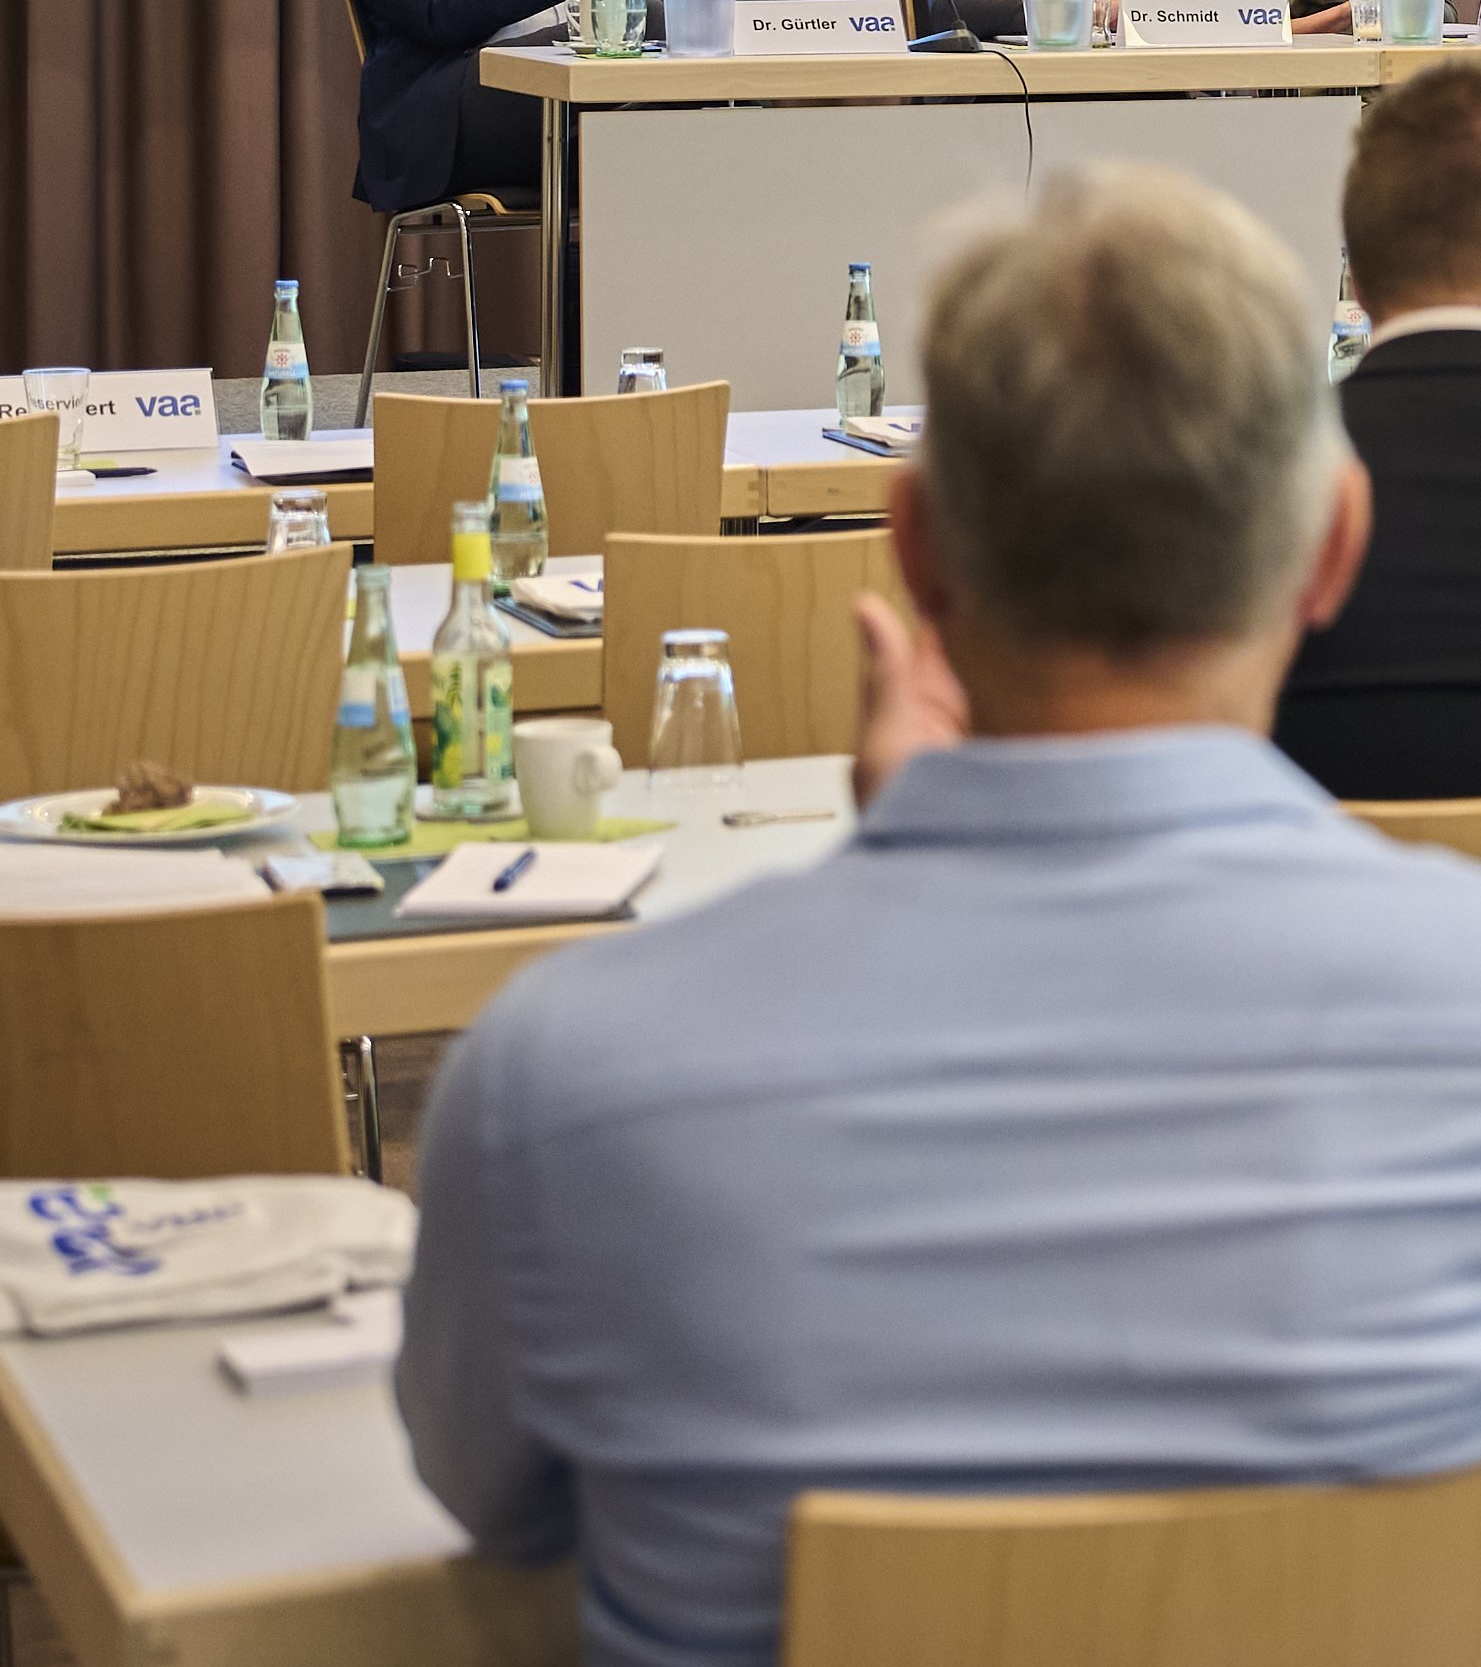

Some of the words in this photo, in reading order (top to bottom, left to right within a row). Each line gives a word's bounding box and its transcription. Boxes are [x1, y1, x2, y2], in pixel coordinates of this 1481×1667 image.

[849, 16, 895, 32] vaa
[1131, 10, 1152, 22] Dr.
[1157, 10, 1219, 23] Schmidt
[1238, 8, 1282, 24] vaa
[753, 19, 776, 31] Dr.
[781, 18, 837, 30] Gürtler
[136, 394, 201, 417] vaa
